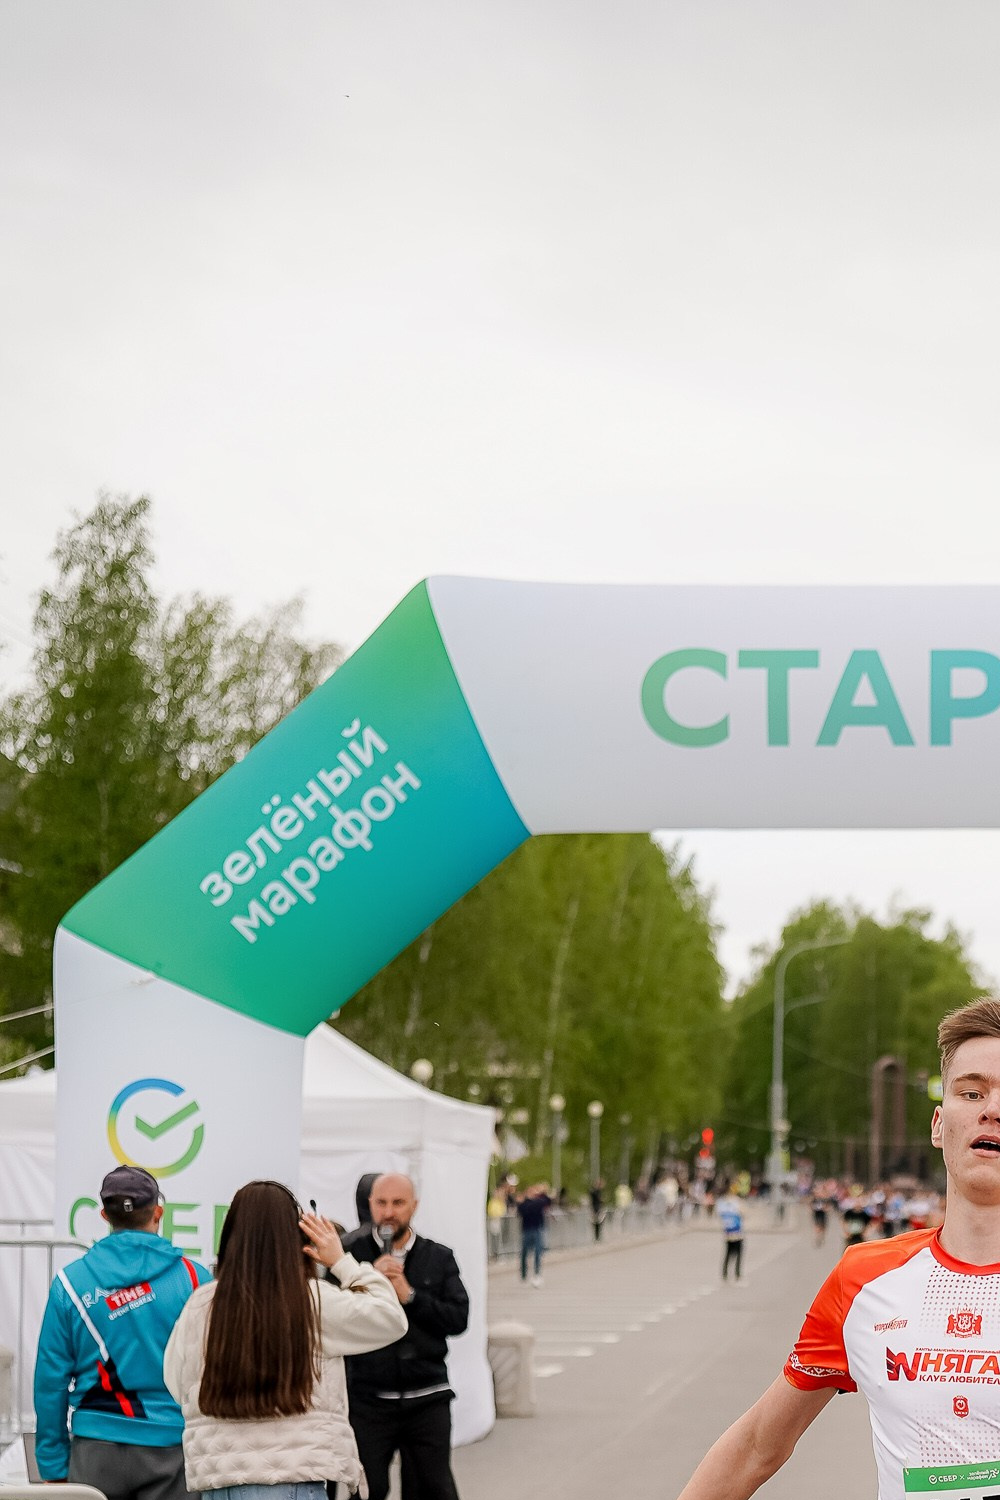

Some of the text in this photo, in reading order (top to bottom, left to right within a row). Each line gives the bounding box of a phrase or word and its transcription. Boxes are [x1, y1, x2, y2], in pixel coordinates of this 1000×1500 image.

[199, 717, 389, 907] зелёный
[229, 760, 422, 944] марафон
[110, 1284, 147, 1307] TIME
[919, 1374, 947, 1382] КЛУБ
[938, 1474, 958, 1483] СБЕР
